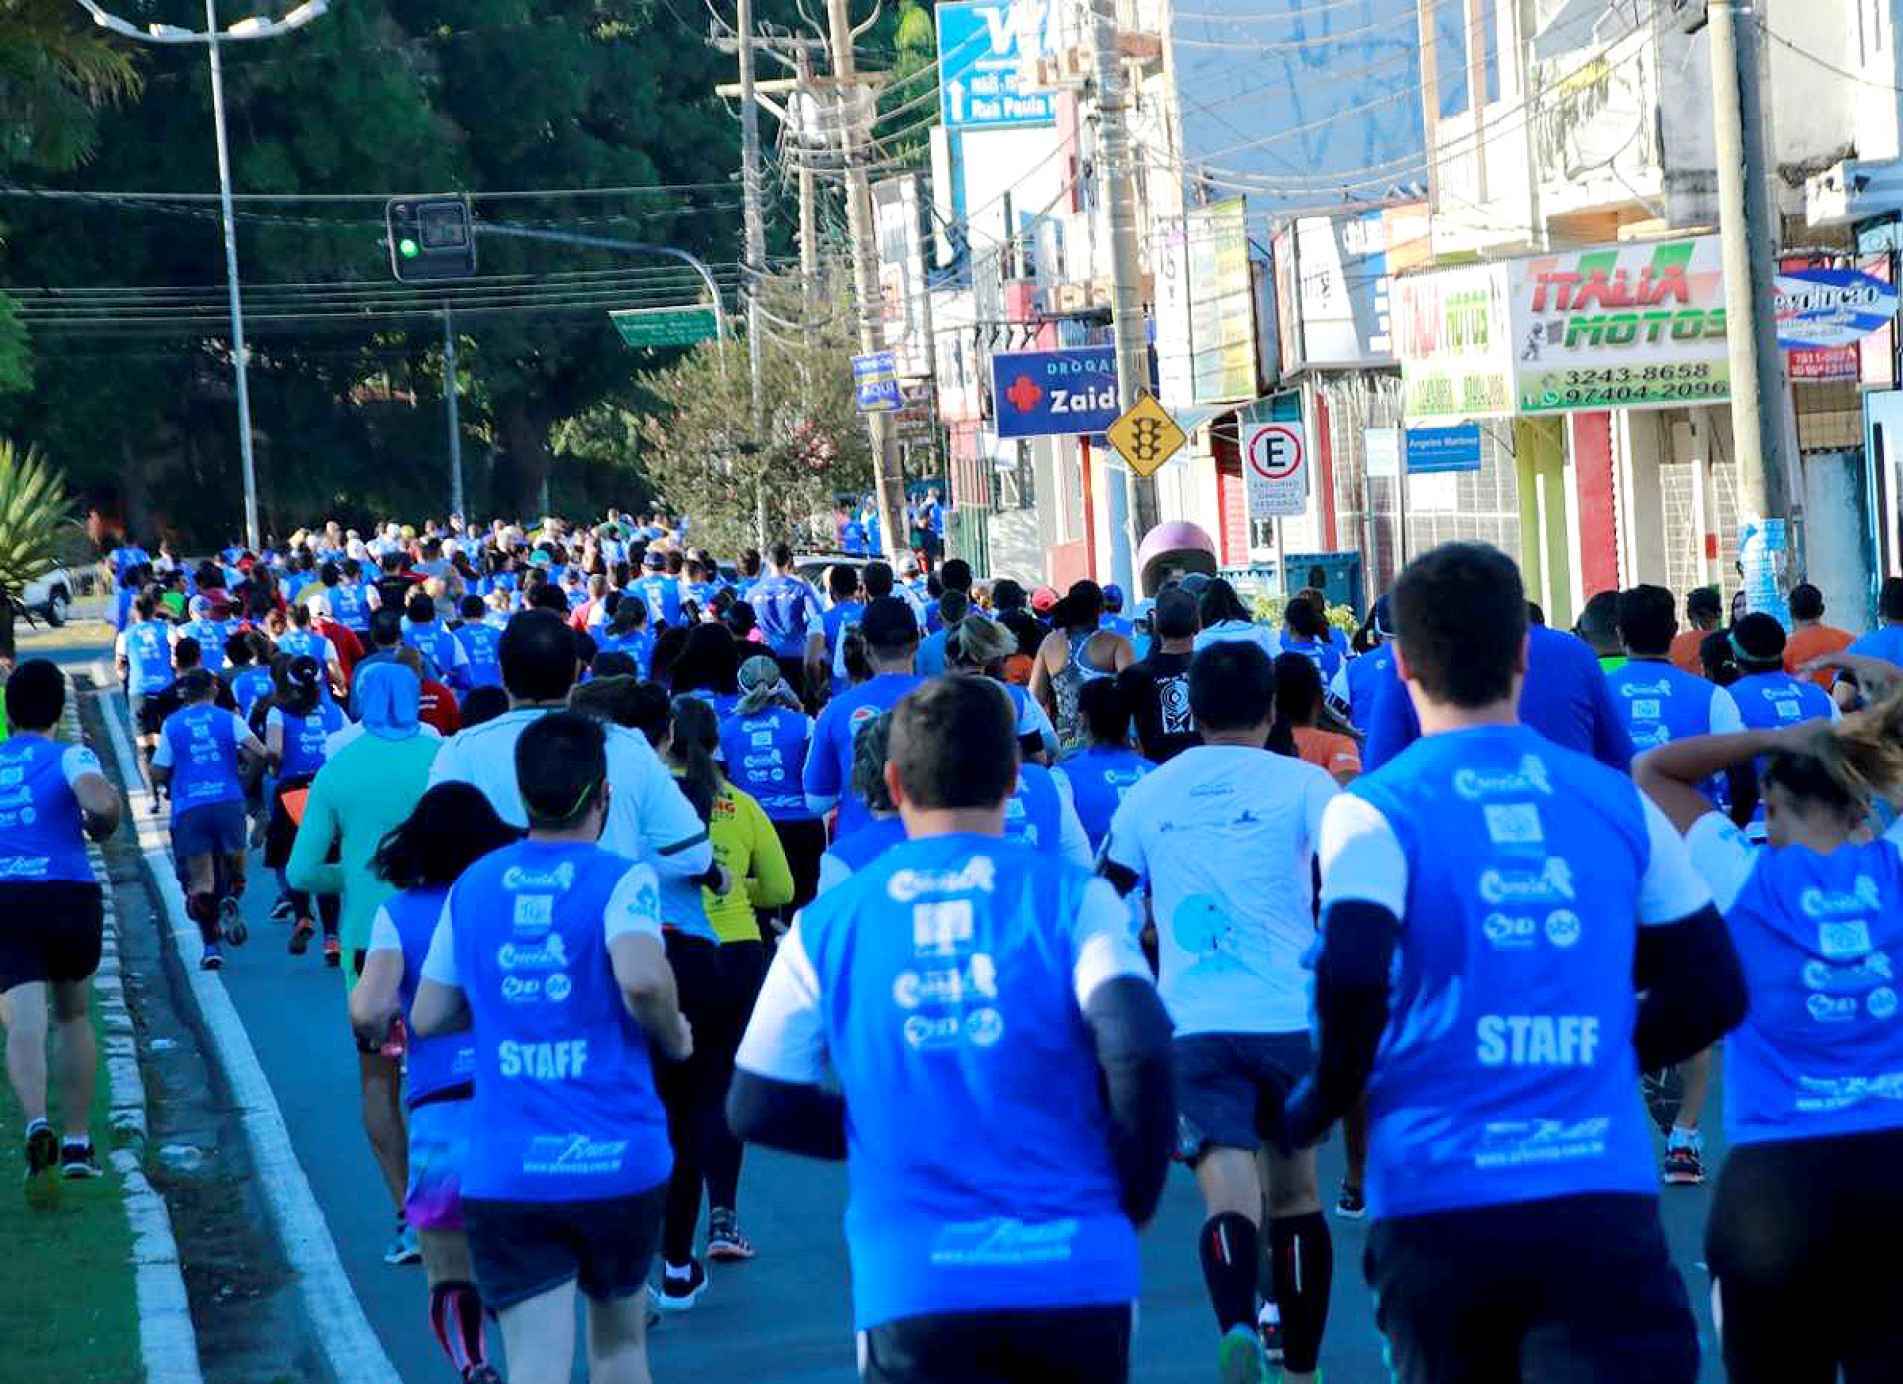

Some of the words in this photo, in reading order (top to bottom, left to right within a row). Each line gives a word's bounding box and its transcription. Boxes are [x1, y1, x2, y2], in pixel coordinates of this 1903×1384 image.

[1003, 95, 1046, 120] Paula
[1531, 264, 1689, 312] ITALIA
[1564, 306, 1728, 348] MOTOS
[1050, 386, 1121, 414] Zaid
[1266, 437, 1286, 467] E
[500, 1038, 588, 1080] STAFF
[1477, 1014, 1599, 1067] STAFF
